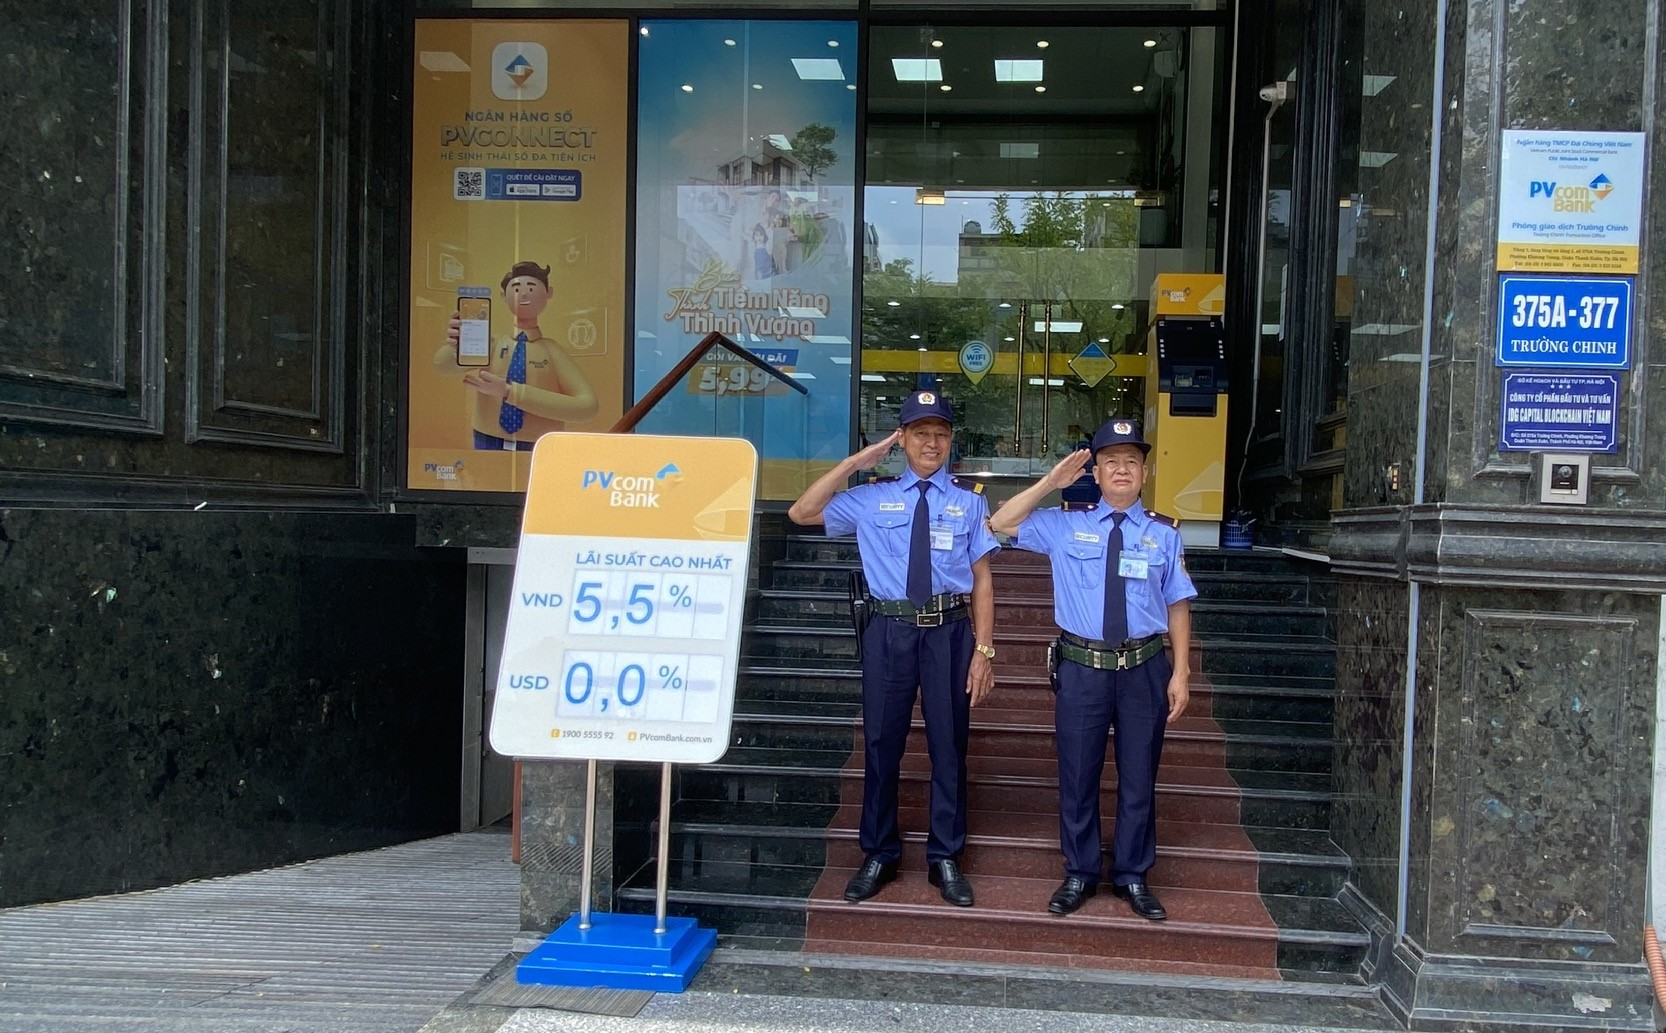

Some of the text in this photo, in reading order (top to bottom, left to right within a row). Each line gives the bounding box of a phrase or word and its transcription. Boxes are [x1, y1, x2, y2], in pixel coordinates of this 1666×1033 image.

[465, 108, 573, 123] NGÂN HÀNG SỐ
[440, 125, 597, 149] PVCONNECT
[457, 152, 483, 161] SINH
[532, 152, 547, 162] ĐA
[1529, 181, 1590, 199] PVcom
[1553, 199, 1596, 213] Bank
[1539, 223, 1555, 231] giao
[772, 288, 830, 317] Năng
[1512, 294, 1567, 328] 375A
[1579, 296, 1619, 329] 377
[1510, 336, 1617, 354] TRƯỜNG CHINH
[1527, 394, 1535, 402] TY
[1520, 408, 1544, 422] CAPITAL
[1596, 409, 1611, 424] NAM
[424, 463, 454, 474] PVcom
[436, 472, 457, 480] Bank
[581, 470, 655, 491] PVcom
[610, 491, 660, 508] Bank
[576, 550, 732, 570] LÃI SUẤT CAO NHẤT
[522, 592, 563, 608] VND
[509, 675, 549, 690] USD
[562, 730, 614, 740] 1900 5555 92
[639, 732, 713, 744] PVcomBank.com.vn
